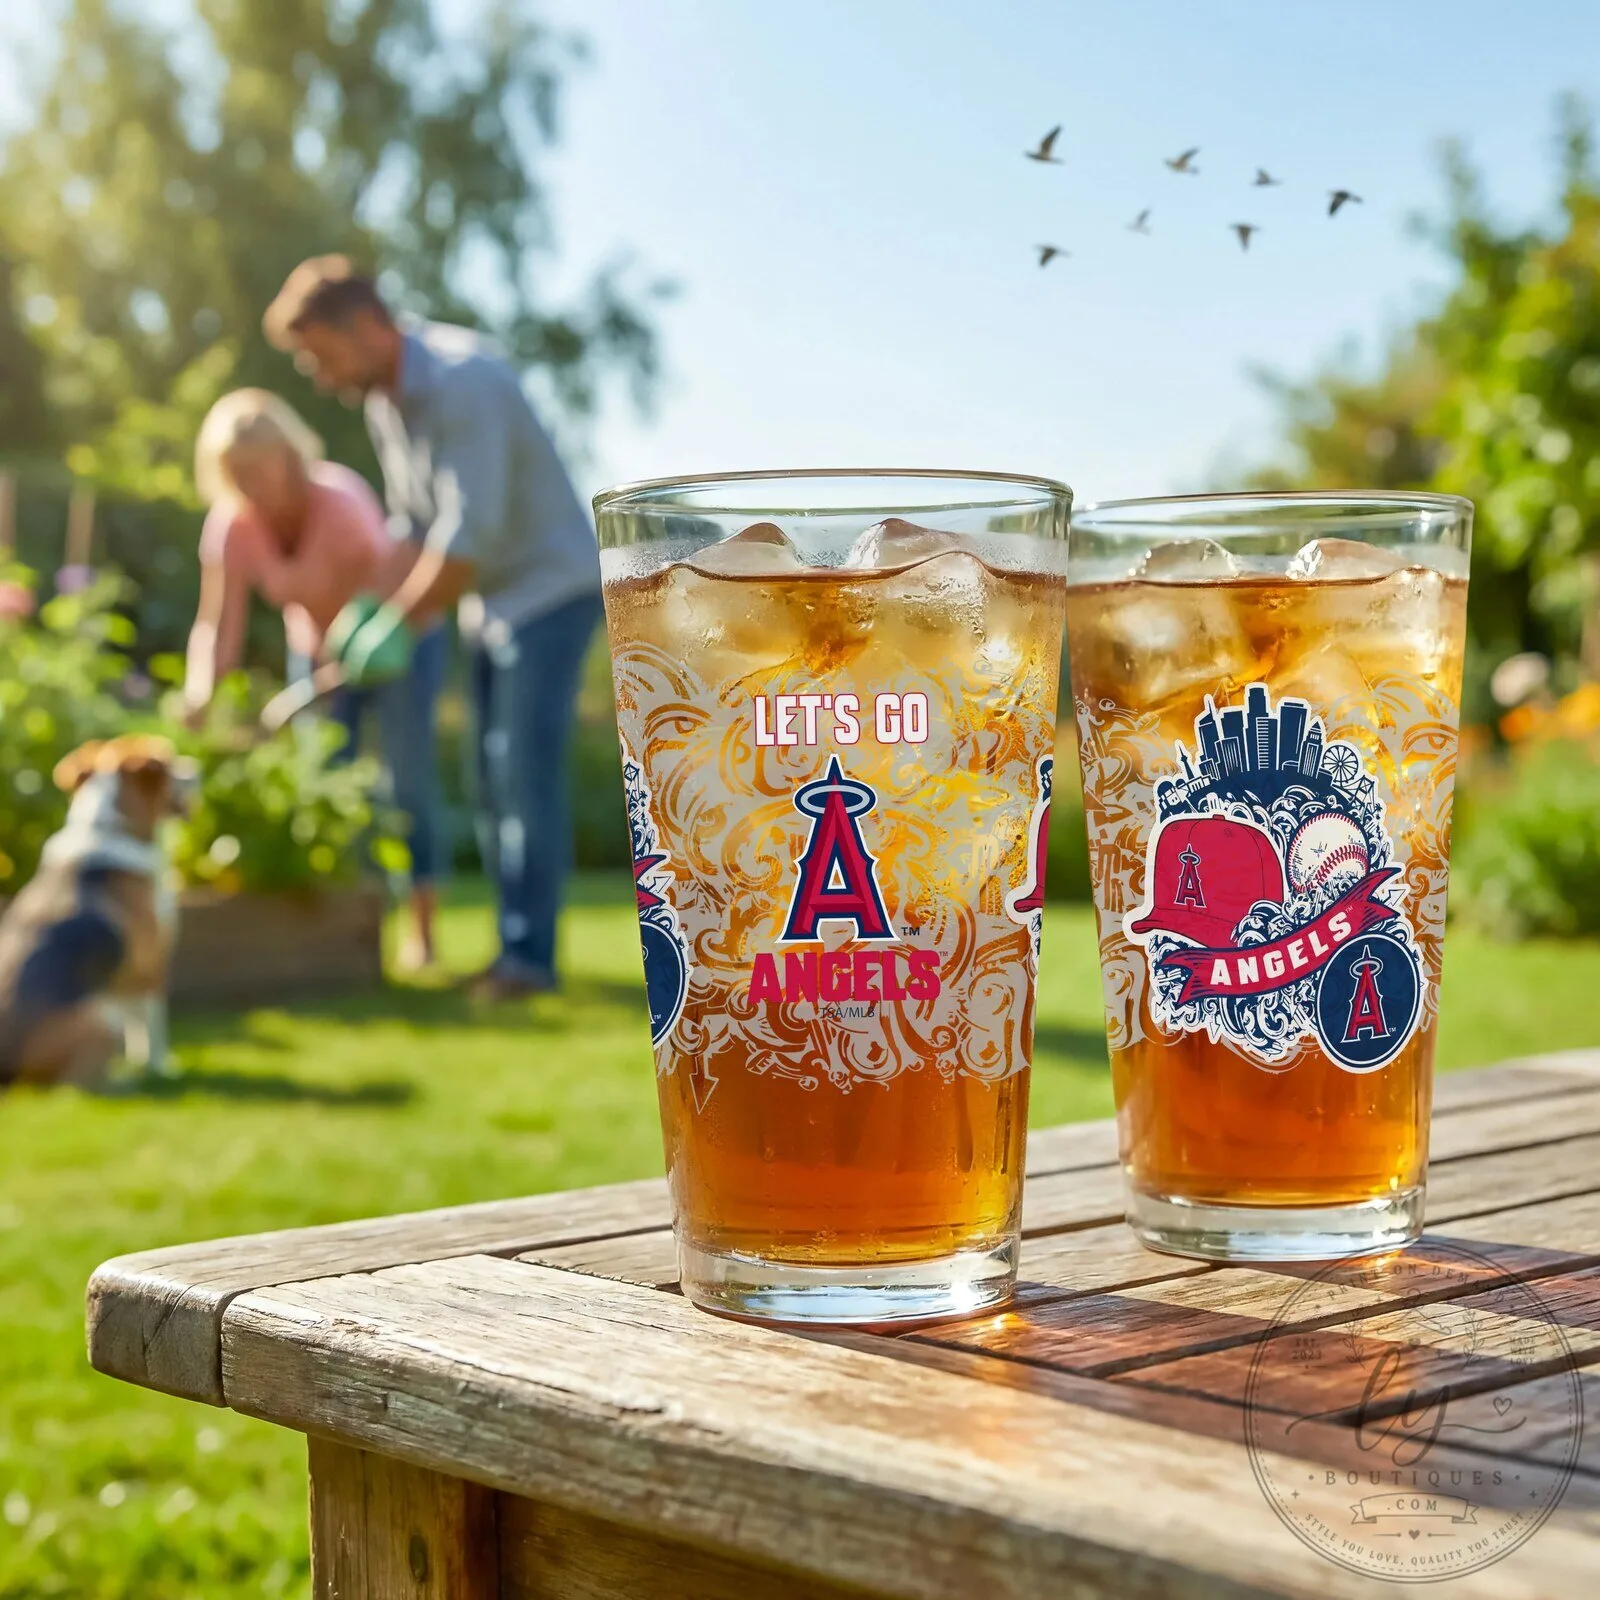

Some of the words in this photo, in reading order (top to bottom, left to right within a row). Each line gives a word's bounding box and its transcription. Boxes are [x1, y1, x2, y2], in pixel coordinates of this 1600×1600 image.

[754, 694, 860, 746] LET'S
[875, 692, 928, 744] GO
[774, 753, 902, 943] A
[1173, 843, 1207, 908] A
[747, 950, 941, 1003] ANGELS
[1210, 911, 1352, 987] ANGELS
[1340, 944, 1391, 1043] A
